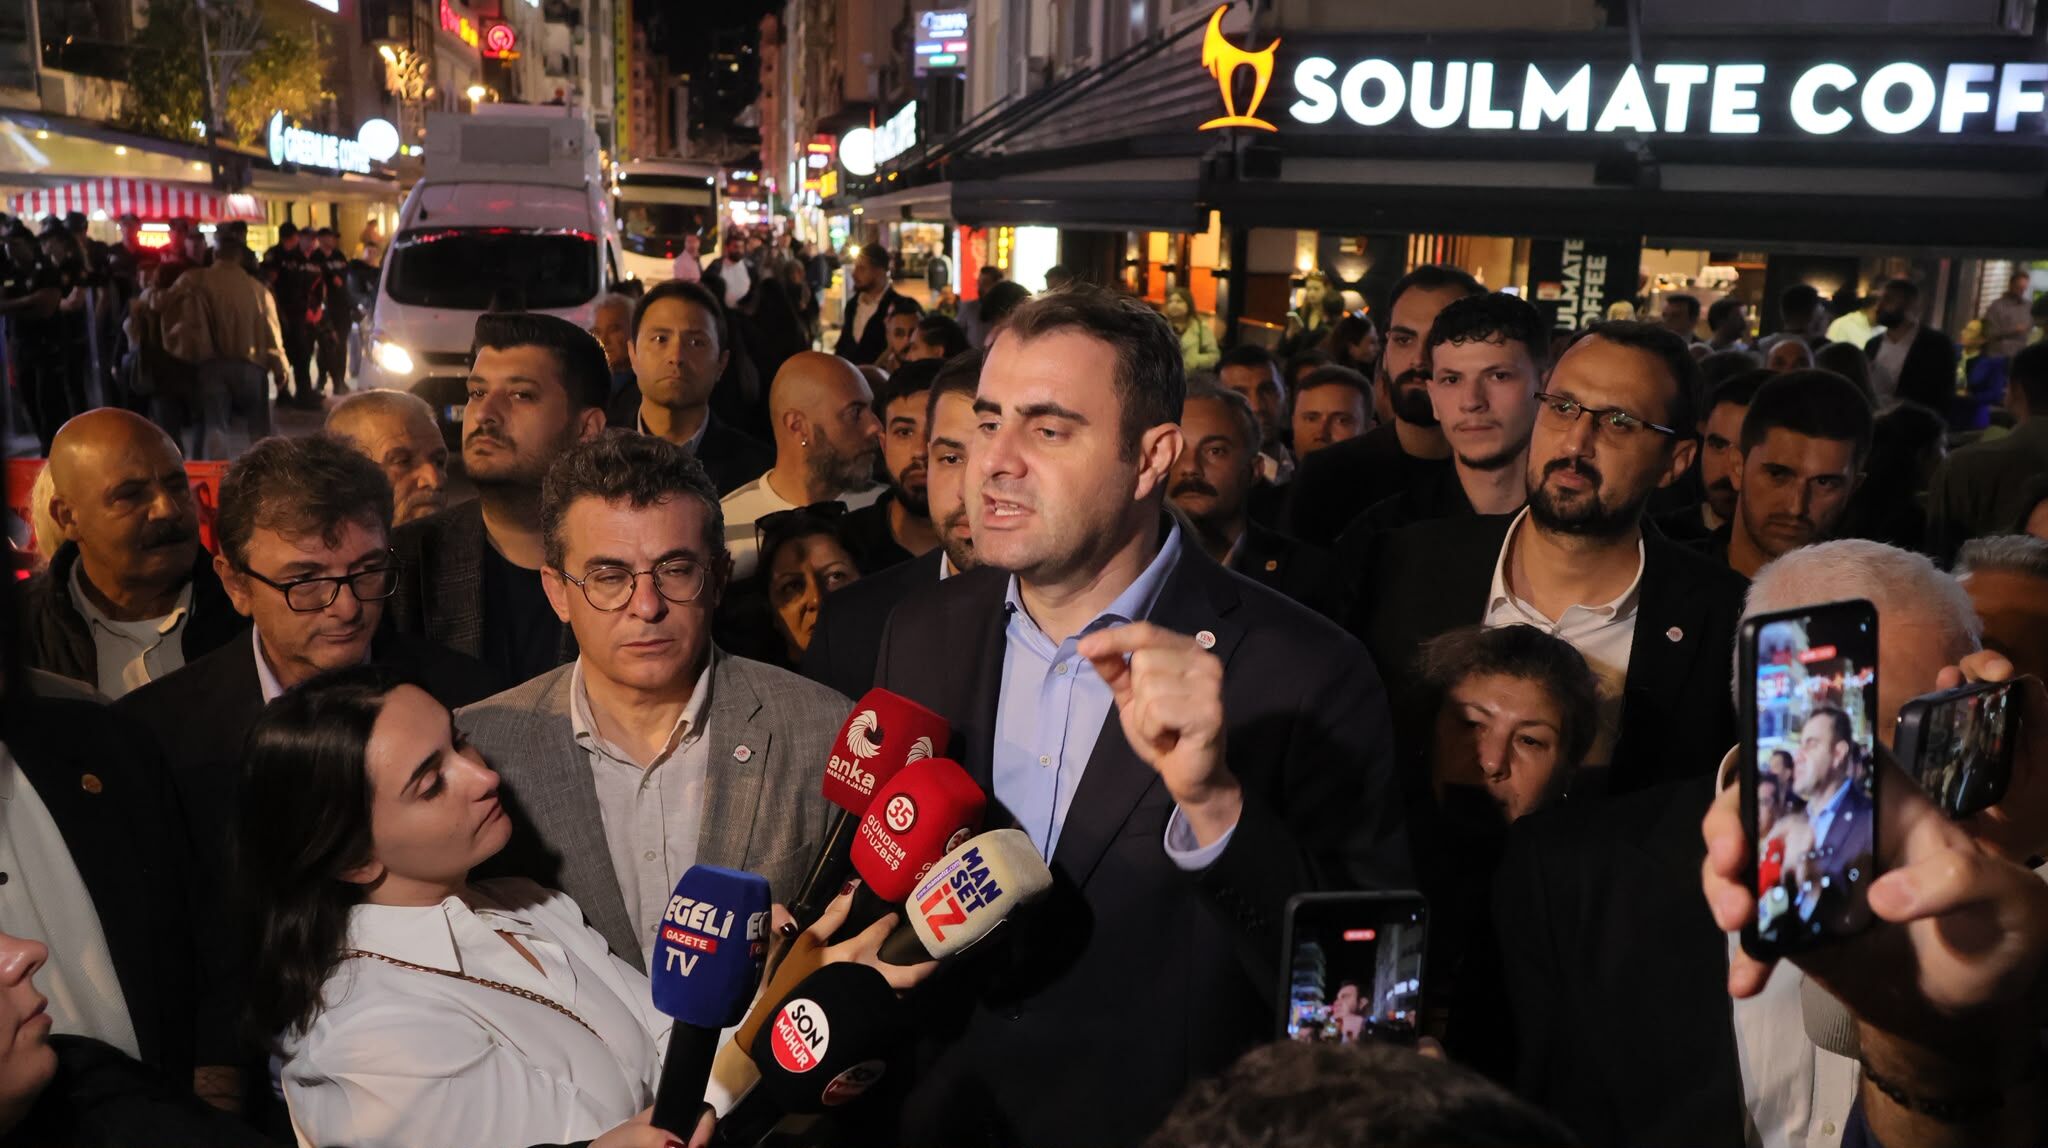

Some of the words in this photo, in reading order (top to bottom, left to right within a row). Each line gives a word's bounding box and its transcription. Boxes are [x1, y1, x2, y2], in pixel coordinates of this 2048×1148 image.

[1288, 56, 1766, 135] SOULMATE
[1790, 61, 2048, 135] COFF
[826, 767, 846, 783] HABER
[845, 778, 872, 796] AJANSI
[828, 754, 876, 790] anka
[888, 798, 913, 827] 35
[861, 823, 900, 872] OTUZBEŞ
[867, 814, 906, 860] GÜNDEM
[950, 869, 986, 913] SET
[961, 846, 1003, 904] MAN
[665, 946, 699, 977] TV
[666, 929, 709, 950] GAZETE
[776, 1016, 809, 1069] MÜHÜR
[791, 1004, 824, 1050] SON
